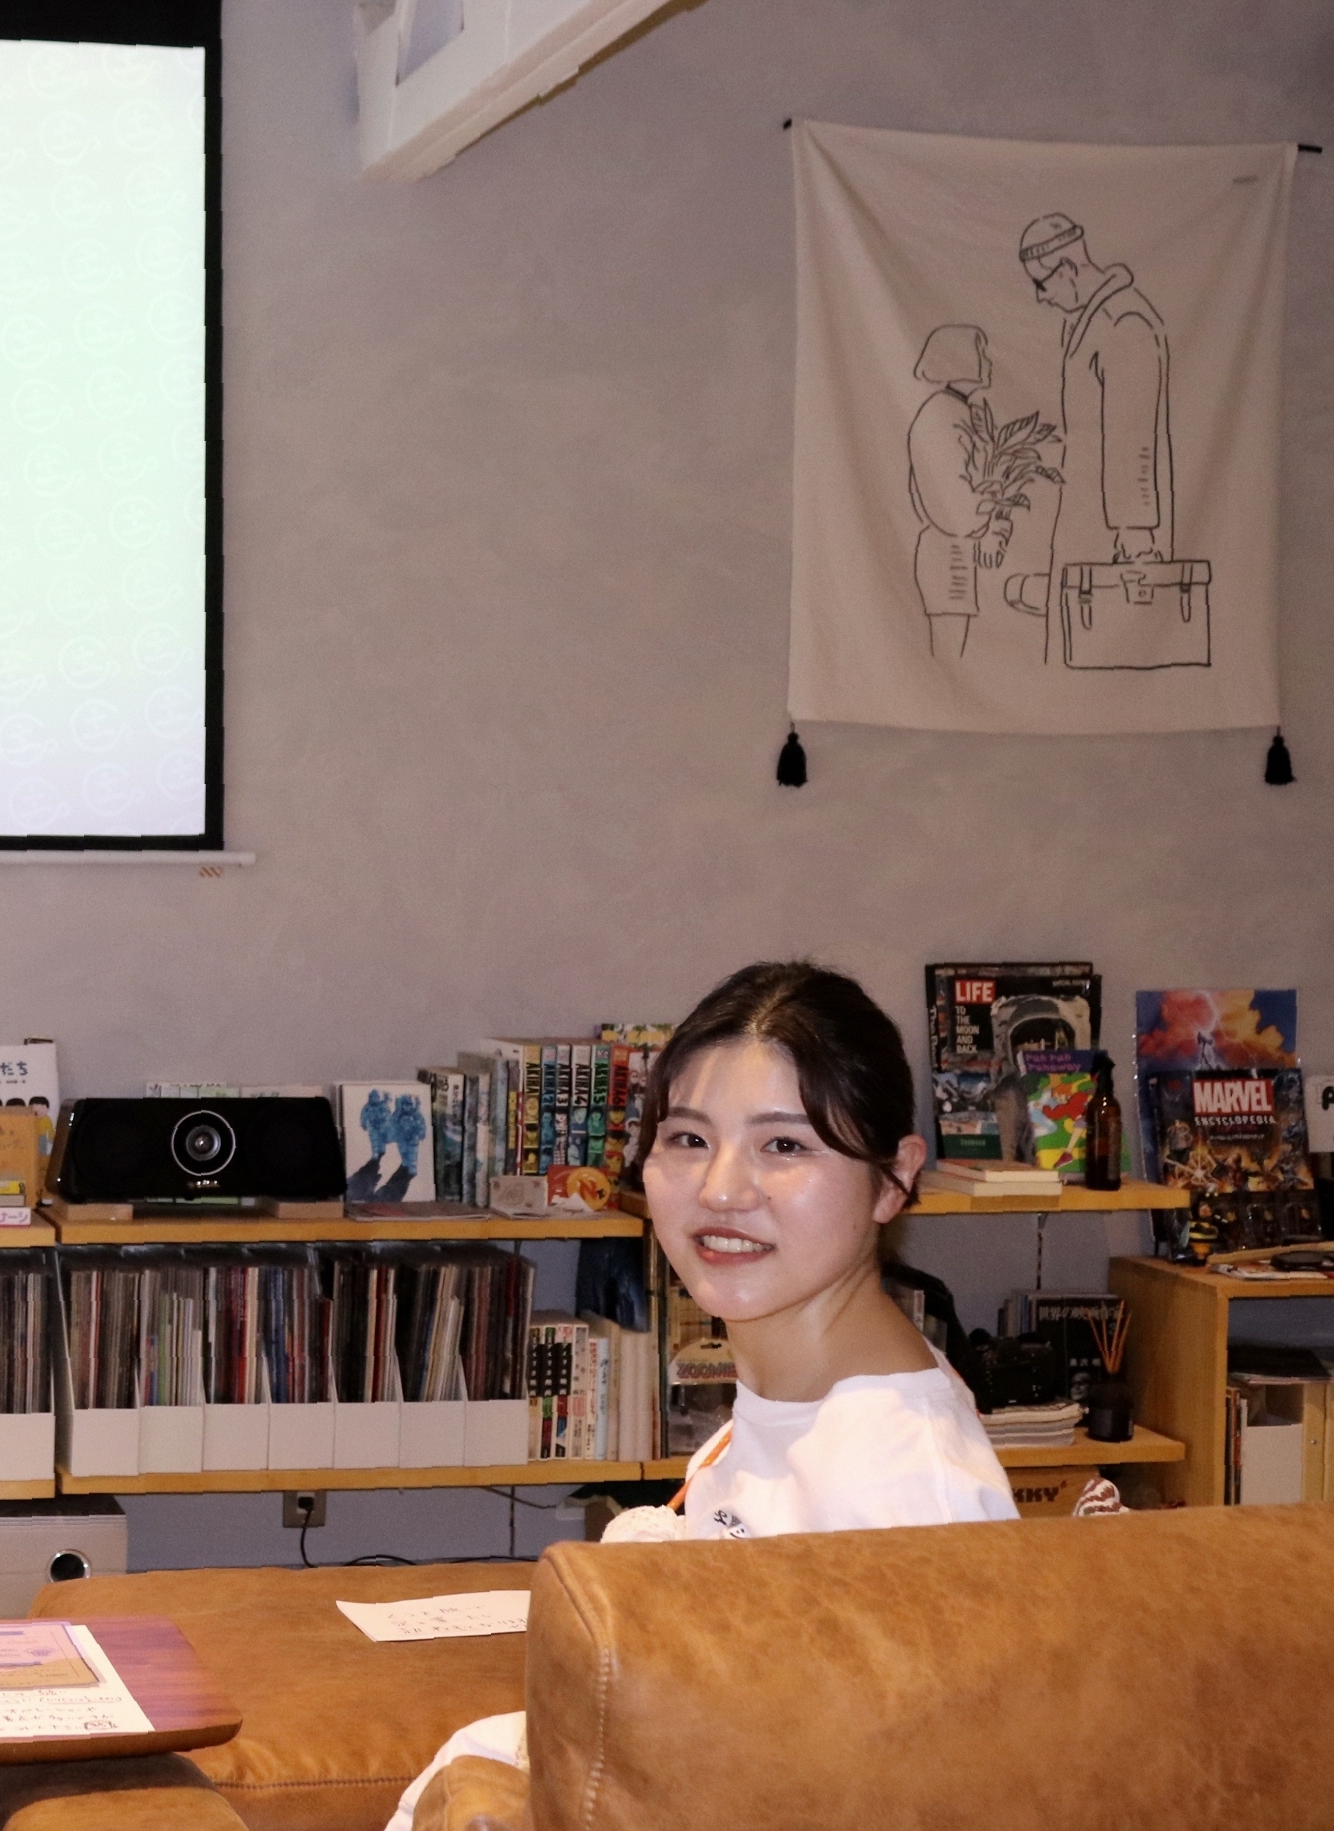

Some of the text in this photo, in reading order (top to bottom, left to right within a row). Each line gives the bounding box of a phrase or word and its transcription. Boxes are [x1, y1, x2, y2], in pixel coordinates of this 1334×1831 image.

[955, 981, 994, 1002] LIFE
[955, 1005, 966, 1015] TO
[956, 1015, 970, 1025] THE
[956, 1025, 980, 1034] MOON
[956, 1035, 973, 1044] AND
[956, 1045, 978, 1054] BACK
[525, 1062, 541, 1095] AKIRA
[1193, 1080, 1273, 1114] MARVEL
[1194, 1115, 1276, 1126] ENCYCLOPEDIA
